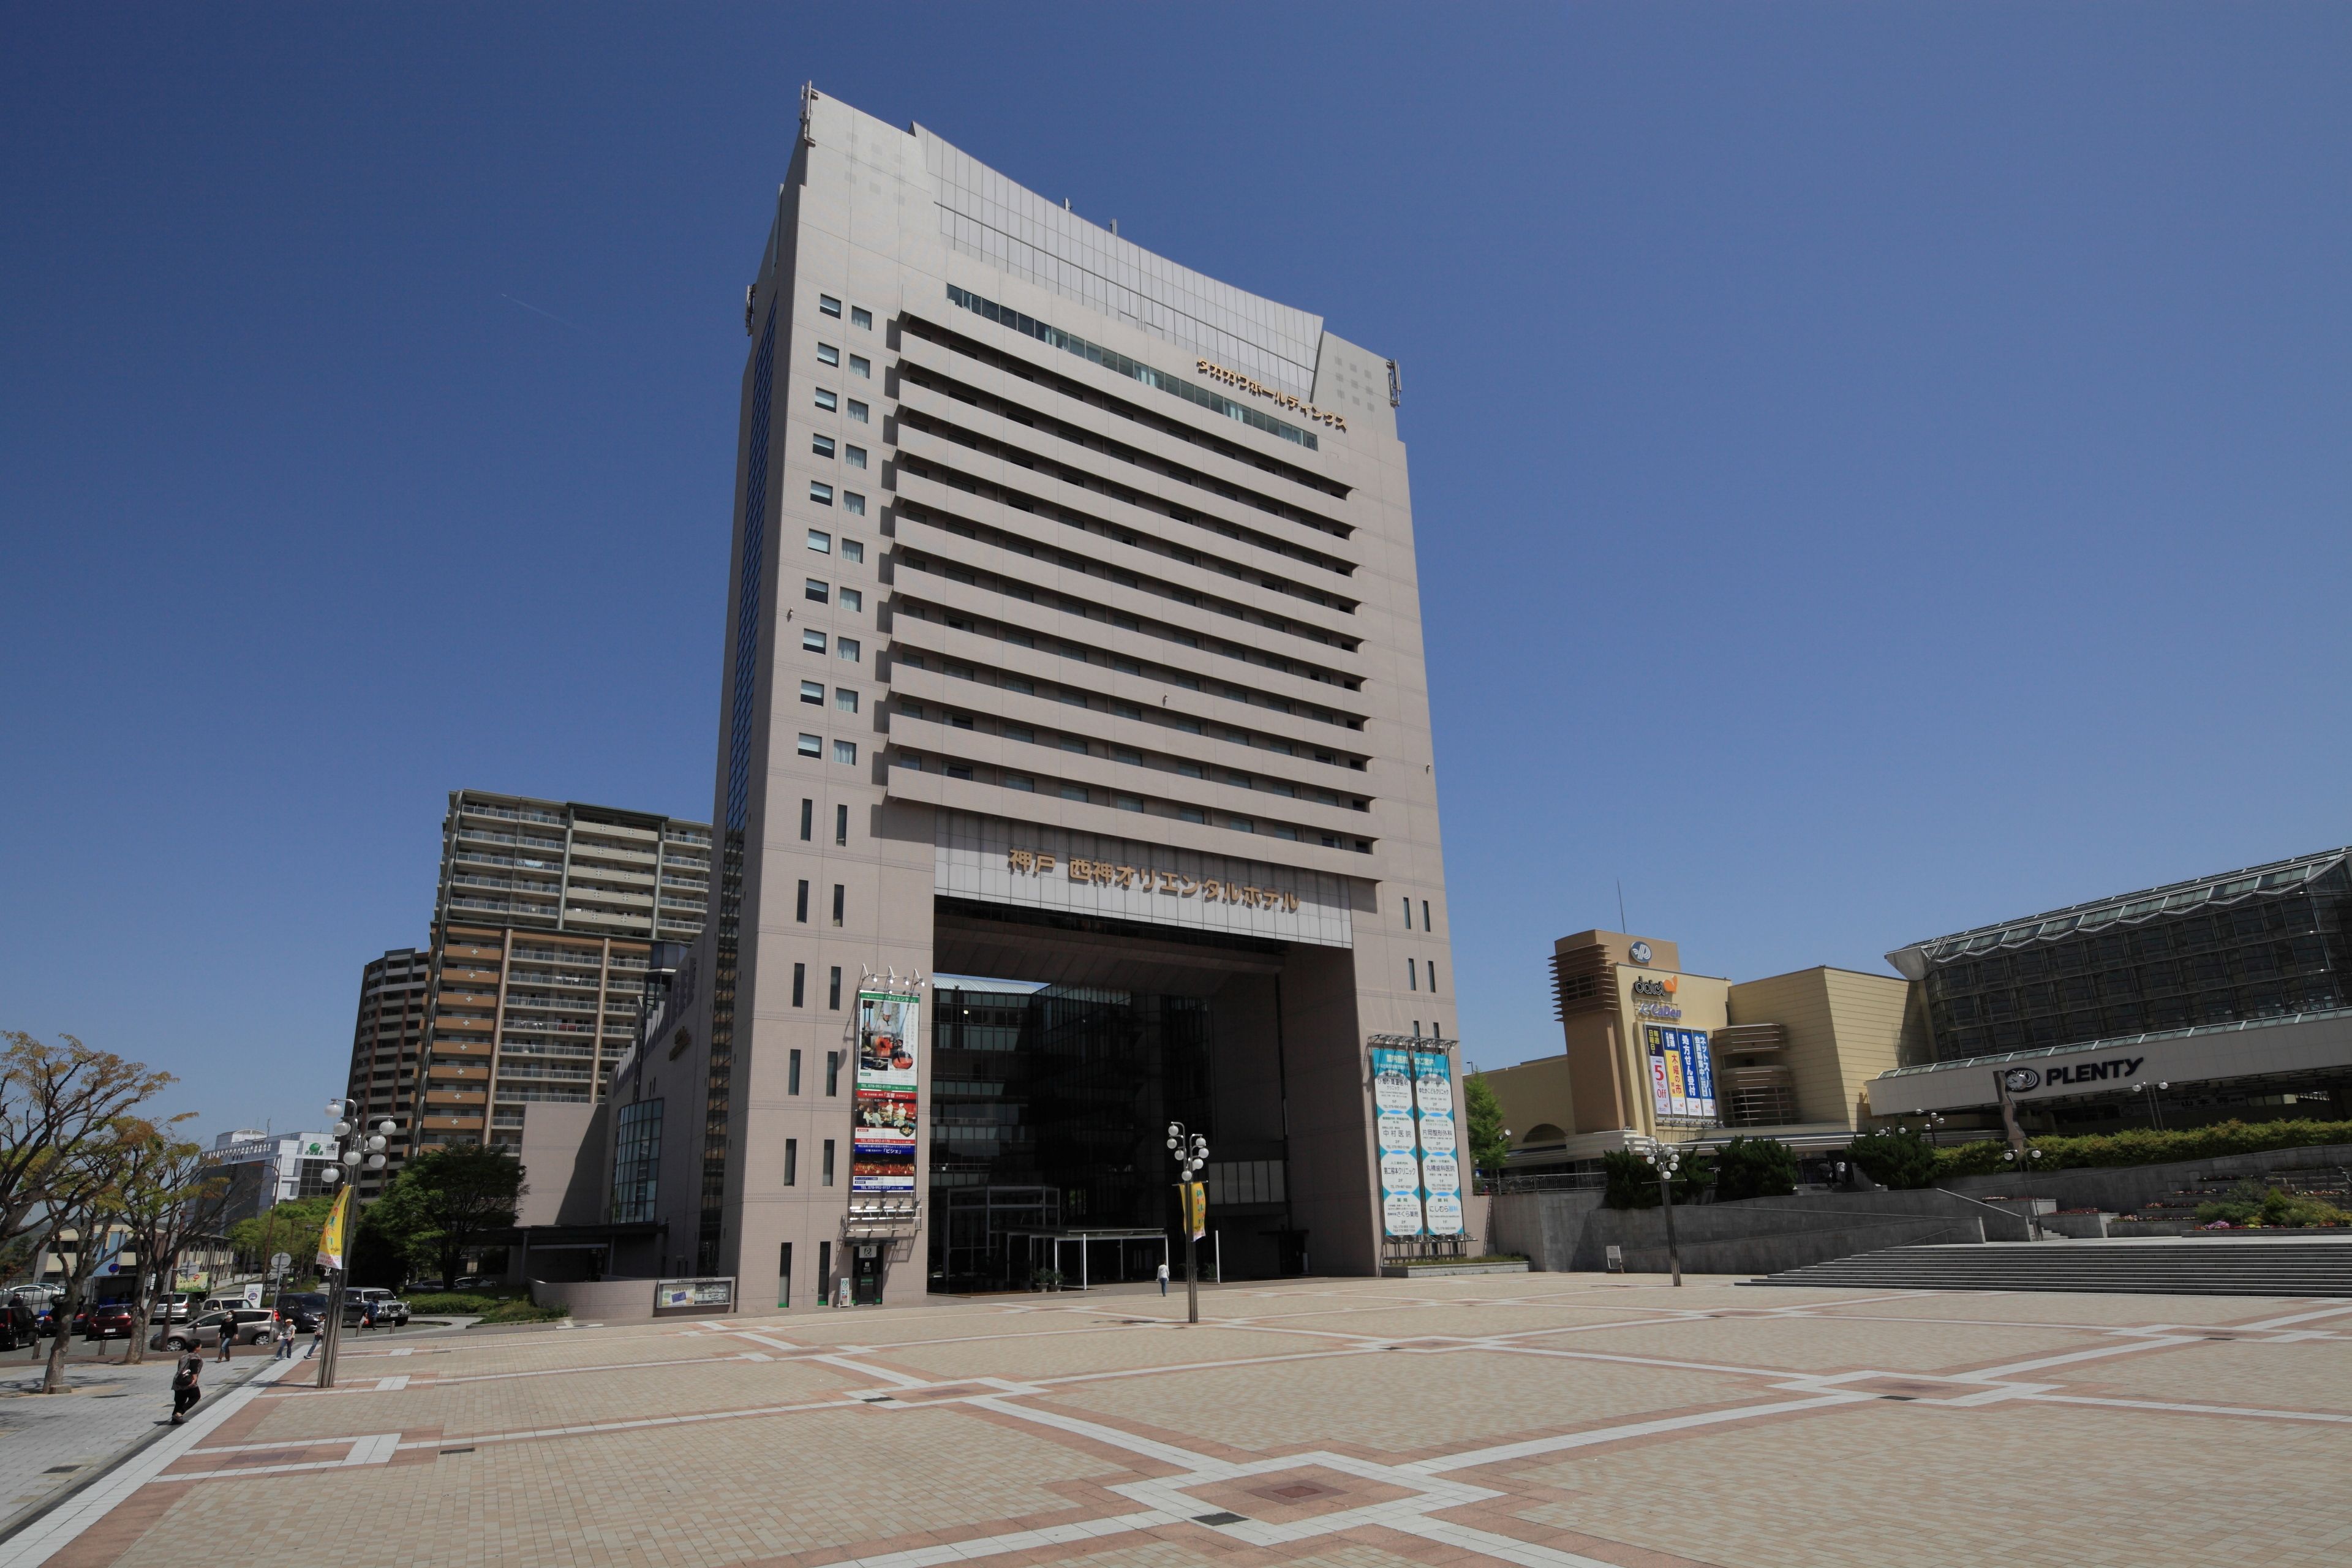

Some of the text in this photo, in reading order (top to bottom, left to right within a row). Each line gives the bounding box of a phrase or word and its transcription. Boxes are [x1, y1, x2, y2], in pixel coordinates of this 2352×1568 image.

[1009, 848, 1300, 913] 神戸 西神オリエンタルホテル
[1654, 1065, 1664, 1081] 5
[1682, 1035, 1696, 1096] 処方せん受付
[1700, 1036, 1712, 1097] ネットスーパー
[2046, 1057, 2144, 1086] PLENTY
[1657, 1088, 1667, 1098] Off
